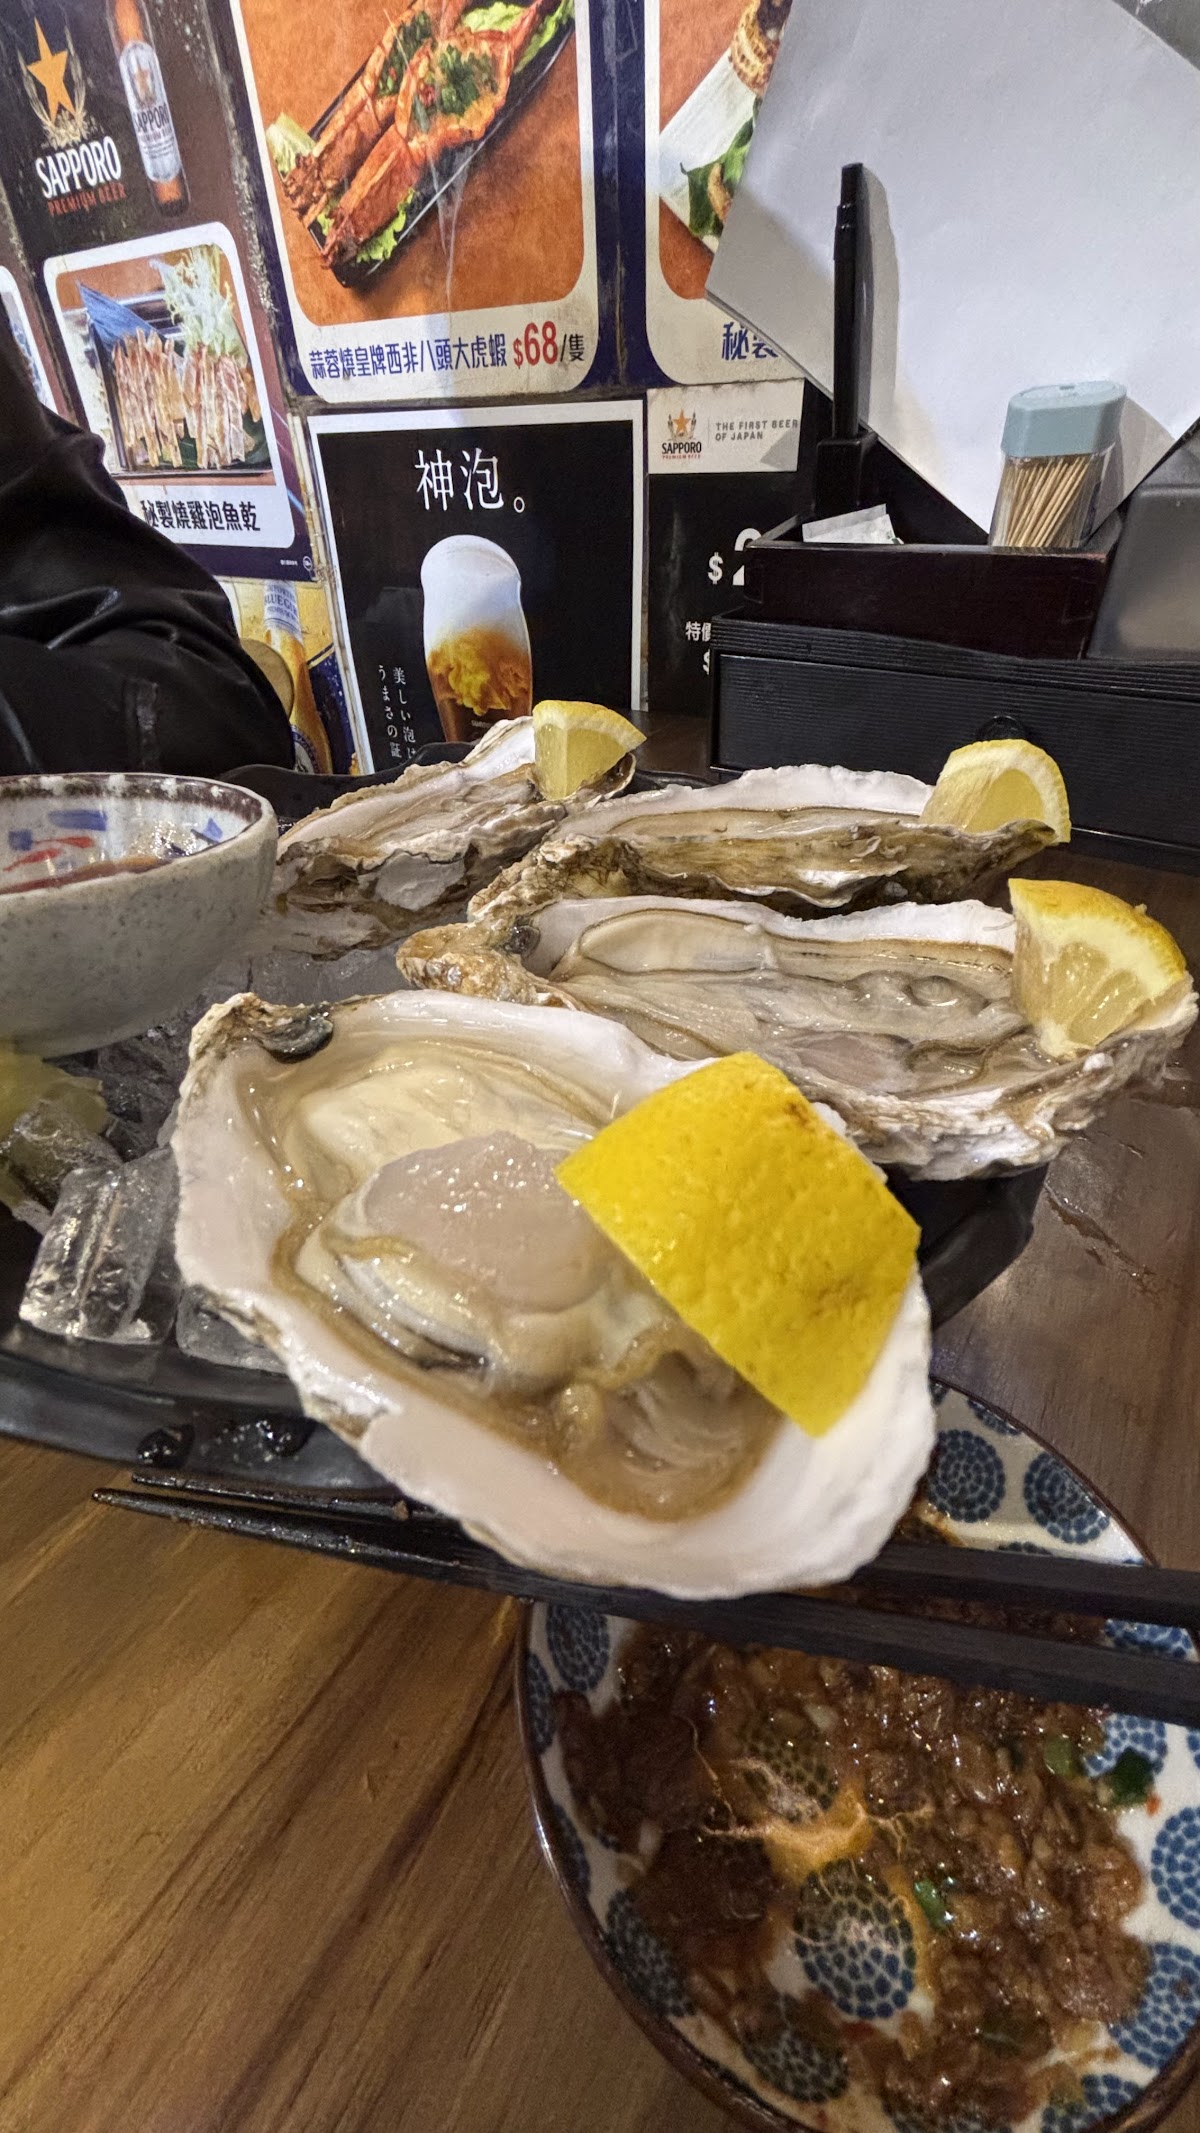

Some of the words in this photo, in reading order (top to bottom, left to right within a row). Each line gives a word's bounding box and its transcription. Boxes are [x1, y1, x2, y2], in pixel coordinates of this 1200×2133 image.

[35, 136, 122, 199] SAPPORO
[308, 333, 507, 379] 蒜蓉燒皇牌西非八頭大虎蝦
[715, 421, 734, 431] THE
[738, 420, 768, 430] FIRST
[771, 418, 798, 429] BEER
[715, 432, 727, 442] OF
[731, 431, 763, 441] JAPAN
[661, 441, 702, 454] SAPPORO
[414, 447, 525, 513] 神泡。
